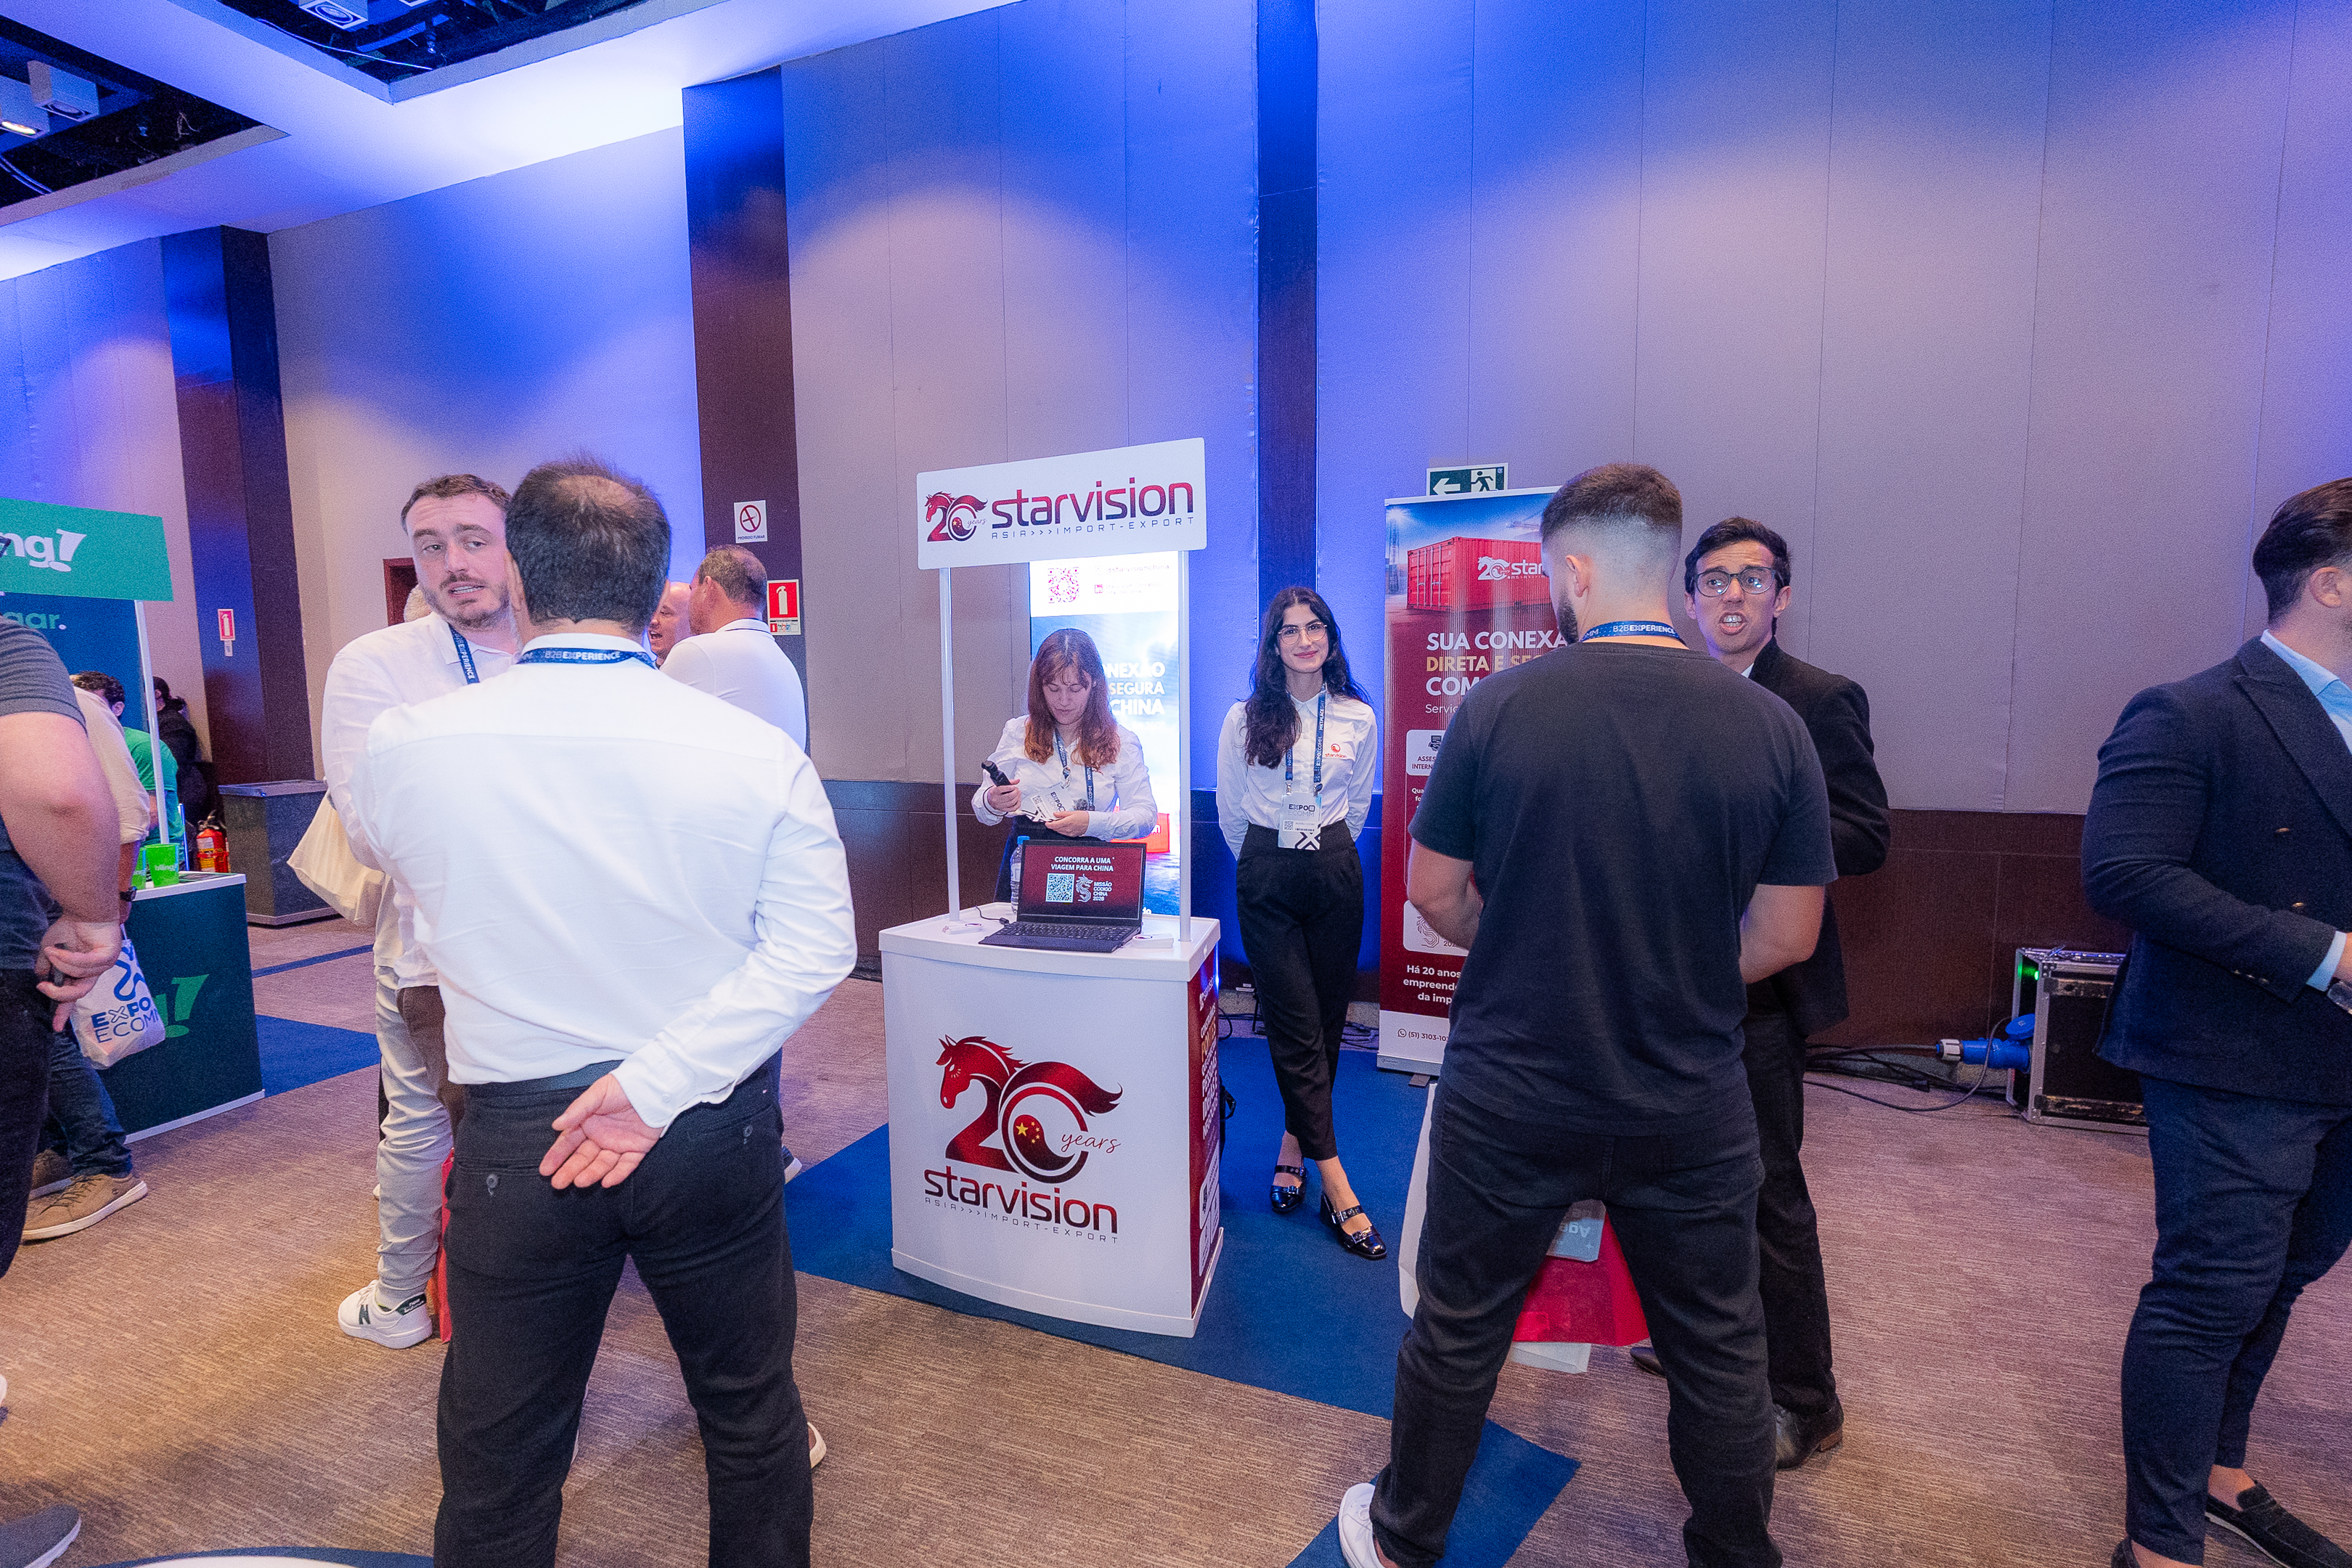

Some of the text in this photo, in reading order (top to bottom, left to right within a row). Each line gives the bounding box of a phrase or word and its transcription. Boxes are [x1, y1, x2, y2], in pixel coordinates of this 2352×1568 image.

[992, 477, 1193, 528] starvision
[1426, 632, 1471, 650] SUA
[1426, 656, 1490, 672] DIRETA
[1494, 656, 1504, 671] E
[1108, 681, 1165, 695] SEGURA
[1109, 698, 1166, 716] CHINA
[1406, 965, 1461, 978] Há 20 anos
[1418, 992, 1430, 1001] da
[91, 997, 151, 1028] EXPO
[1408, 1031, 1420, 1040] (51)
[1060, 1132, 1121, 1154] years
[923, 1165, 1118, 1235] starvision
